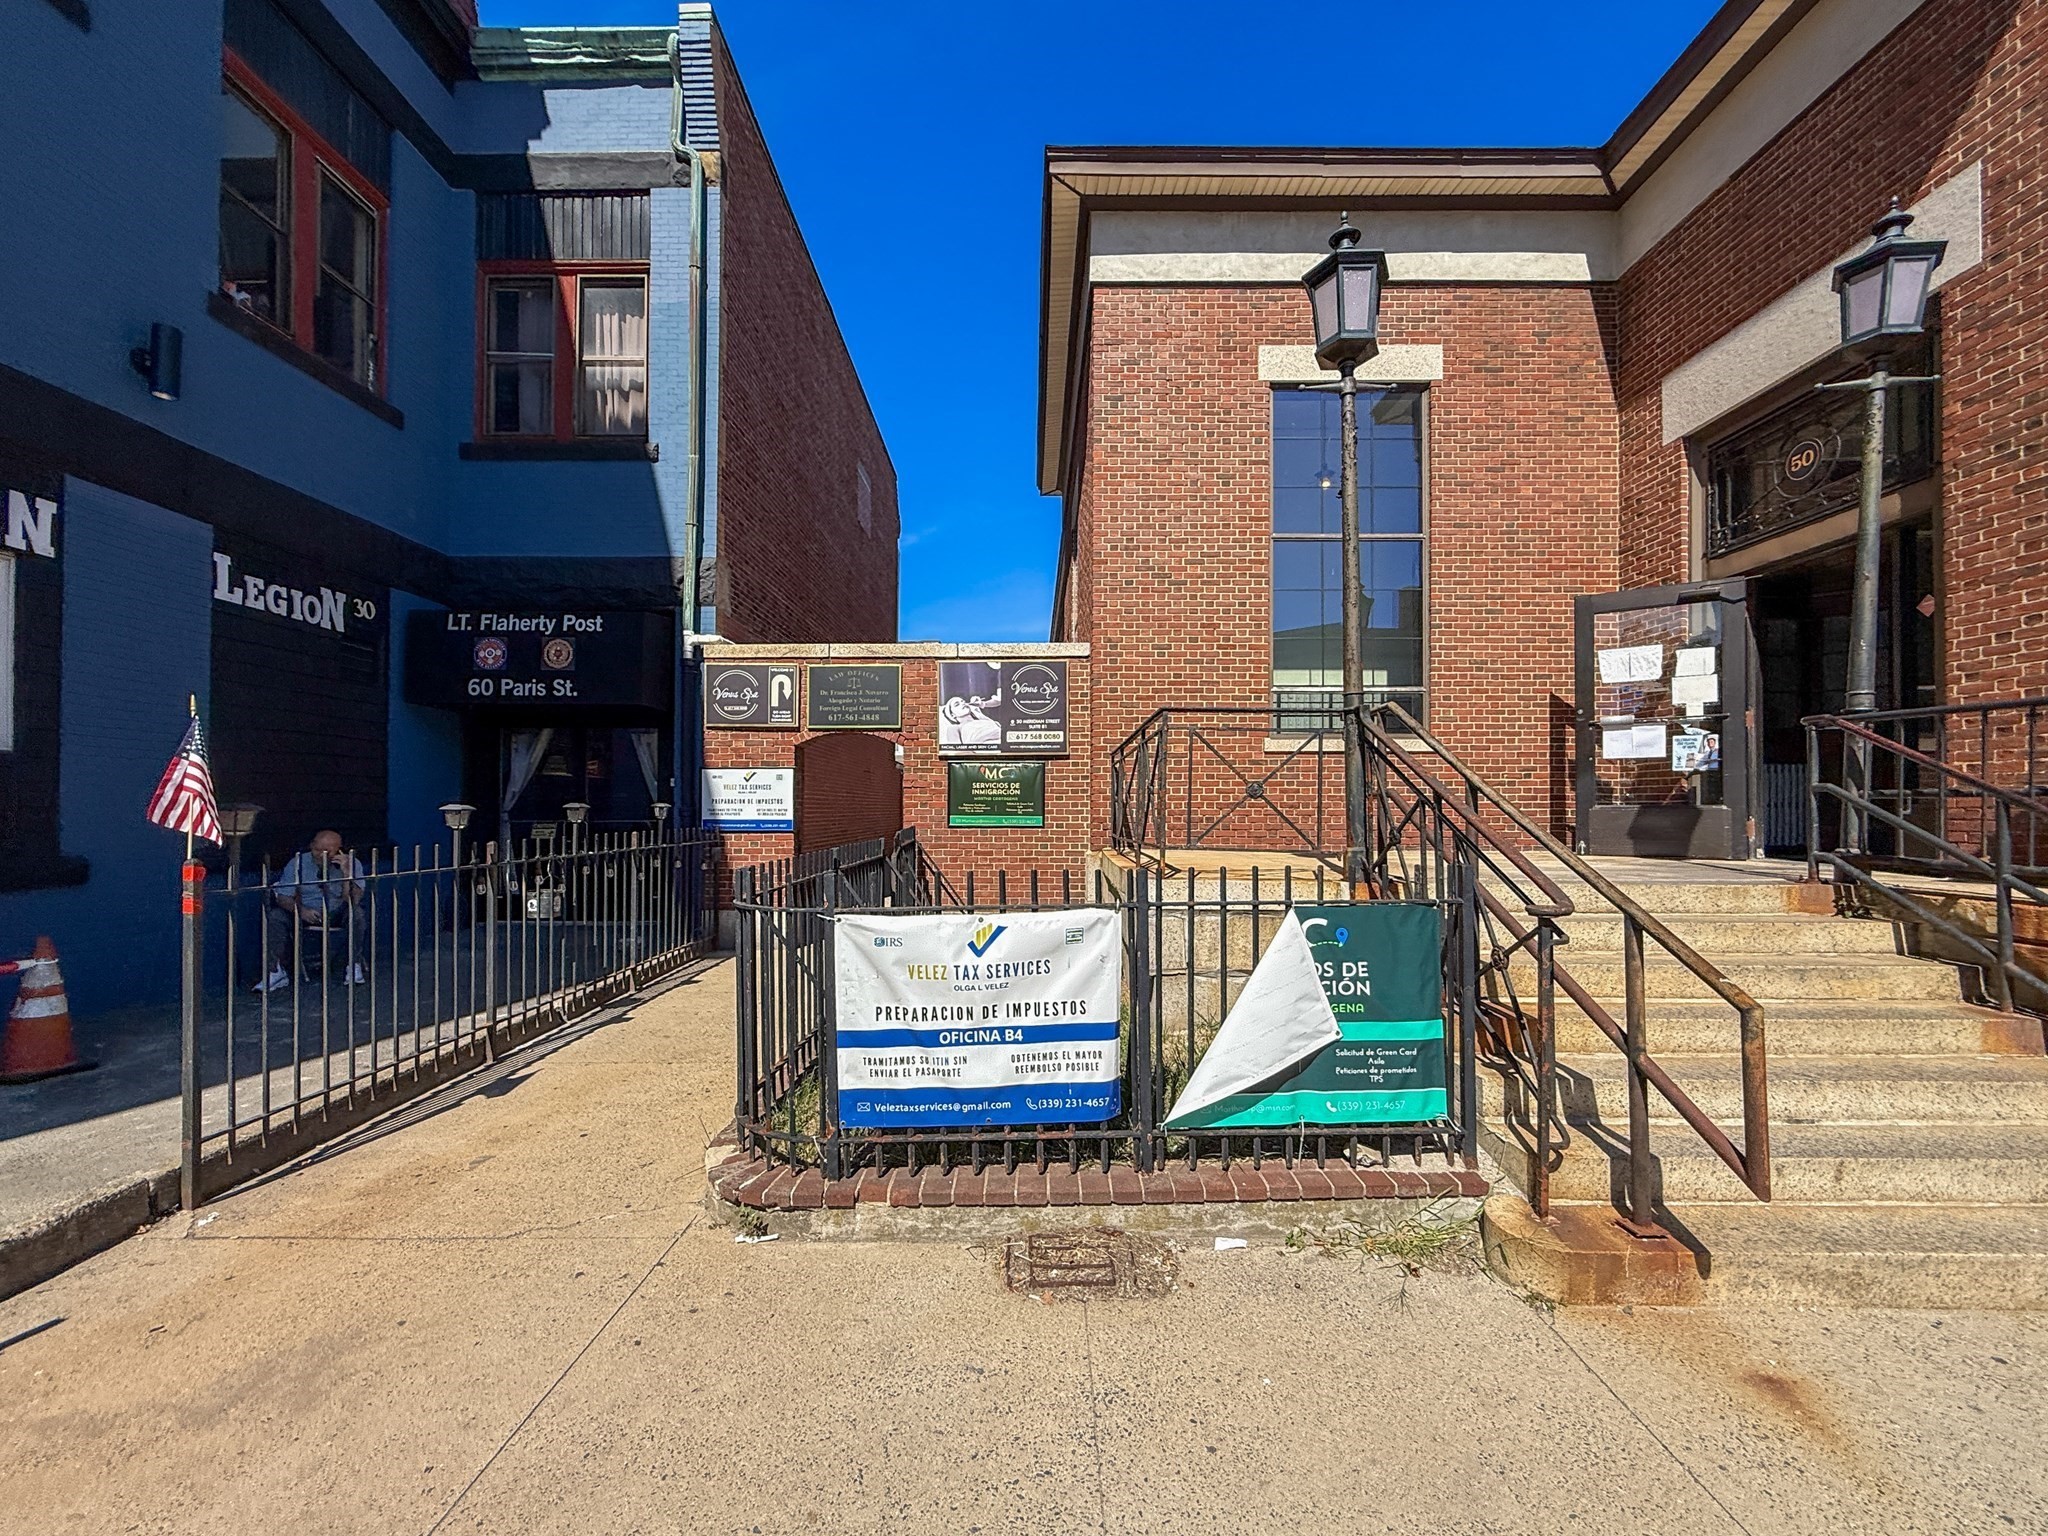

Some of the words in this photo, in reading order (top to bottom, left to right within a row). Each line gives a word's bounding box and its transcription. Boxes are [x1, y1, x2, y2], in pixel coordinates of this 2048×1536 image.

[1790, 449, 1814, 472] 50
[4, 489, 57, 558] N
[212, 551, 347, 633] LEGION
[353, 598, 376, 620] 30
[447, 614, 472, 631] LT.
[480, 614, 556, 634] Flaherty
[562, 614, 603, 631] Post
[828, 672, 844, 682] LAW
[847, 670, 879, 681] OFFICES
[467, 678, 494, 696] 60
[500, 678, 546, 696] Paris
[552, 678, 578, 697] St.
[1010, 681, 1038, 695] Venus
[1039, 681, 1059, 699] Spa
[712, 686, 739, 700] Venus
[740, 687, 759, 705] Spa
[828, 713, 880, 721] 617-561-4848
[985, 767, 1016, 779] MC
[971, 787, 1021, 795] INMIGRACIÓN
[885, 937, 903, 947] IRS
[907, 963, 948, 981] VELEZ
[953, 964, 980, 981] TAX
[986, 959, 1051, 979] SERVICES
[1342, 961, 1369, 977] DE
[953, 984, 977, 992] OLGA
[984, 982, 1009, 991] VELEZ
[875, 1005, 974, 1023] PREPARACION
[982, 1004, 999, 1019] DE
[1006, 1000, 1088, 1018] IMPUESTOS
[939, 1029, 1001, 1044] OFICINA
[1004, 1028, 1023, 1042] B4
[1010, 1051, 1059, 1064] OBTENEMOS
[1062, 1051, 1072, 1061] EL
[1074, 1050, 1103, 1060] MAYOR
[1335, 1047, 1364, 1057] Solicitud
[1365, 1047, 1375, 1056] de
[1376, 1047, 1398, 1056] Green
[1398, 1047, 1417, 1056] Card
[862, 1055, 917, 1067] TRAMITAMOS
[919, 1056, 930, 1065] SU
[932, 1056, 949, 1066] ITIN
[953, 1055, 968, 1066] SIN
[1367, 1057, 1385, 1065] Asilo
[869, 1067, 900, 1078] ENVIAR
[902, 1067, 912, 1077] EL
[915, 1067, 962, 1078] PASAPORTE
[1014, 1062, 1062, 1074] REEMBOLSO
[1065, 1062, 1100, 1073] POSIBLE
[1335, 1066, 1368, 1075] Peticiones
[1369, 1066, 1378, 1074] de
[1380, 1066, 1417, 1075] prometidos
[1368, 1075, 1384, 1083] TPS
[874, 1100, 1012, 1113] Veleztaxservices@gmail.com
[1038, 1098, 1063, 1109] (339)
[1064, 1097, 1110, 1108] 231-4657
[1337, 1100, 1363, 1112] (339)
[1365, 1100, 1406, 1111] 231-4657
